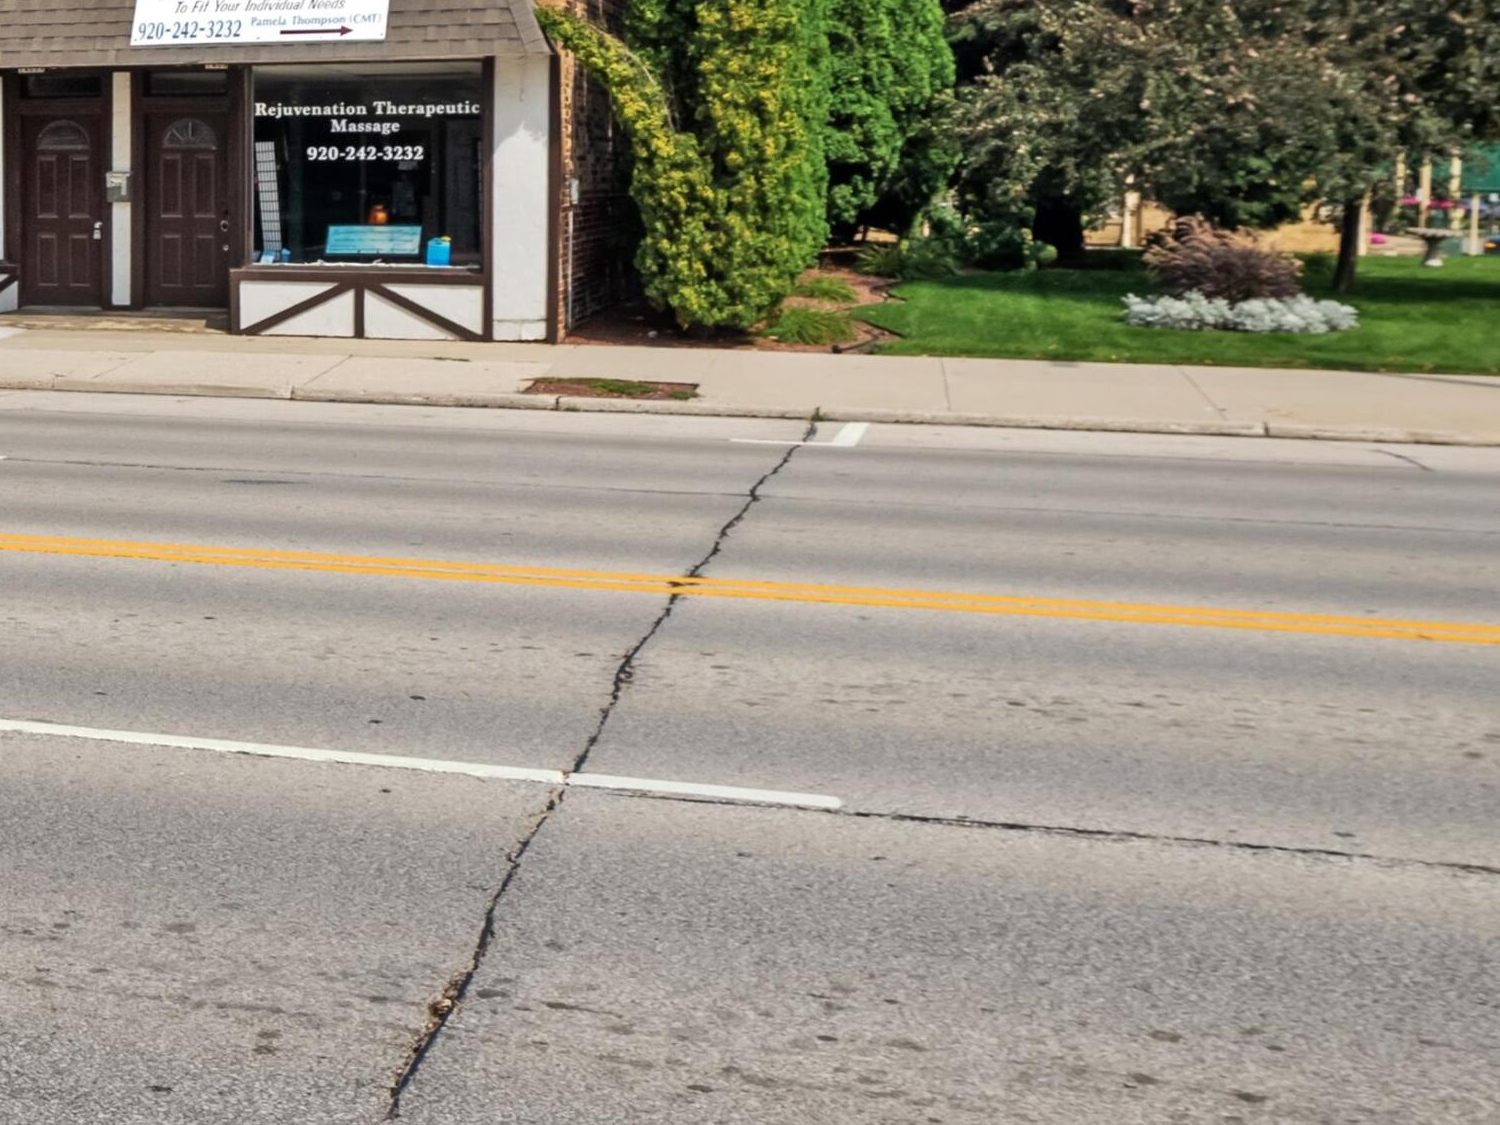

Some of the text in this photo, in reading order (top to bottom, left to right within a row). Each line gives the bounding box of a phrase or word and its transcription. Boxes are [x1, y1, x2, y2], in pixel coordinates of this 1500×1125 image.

[174, 1, 189, 14] To
[191, 0, 210, 13] Fit
[215, 0, 241, 13] Your
[250, 15, 287, 27] Pamela
[292, 14, 346, 26] Thompson
[138, 20, 242, 40] 920-242-3232
[254, 100, 480, 119] Rejuvenation Therapeutic
[330, 119, 400, 134] Massage
[306, 146, 424, 161] 920-242-3232
